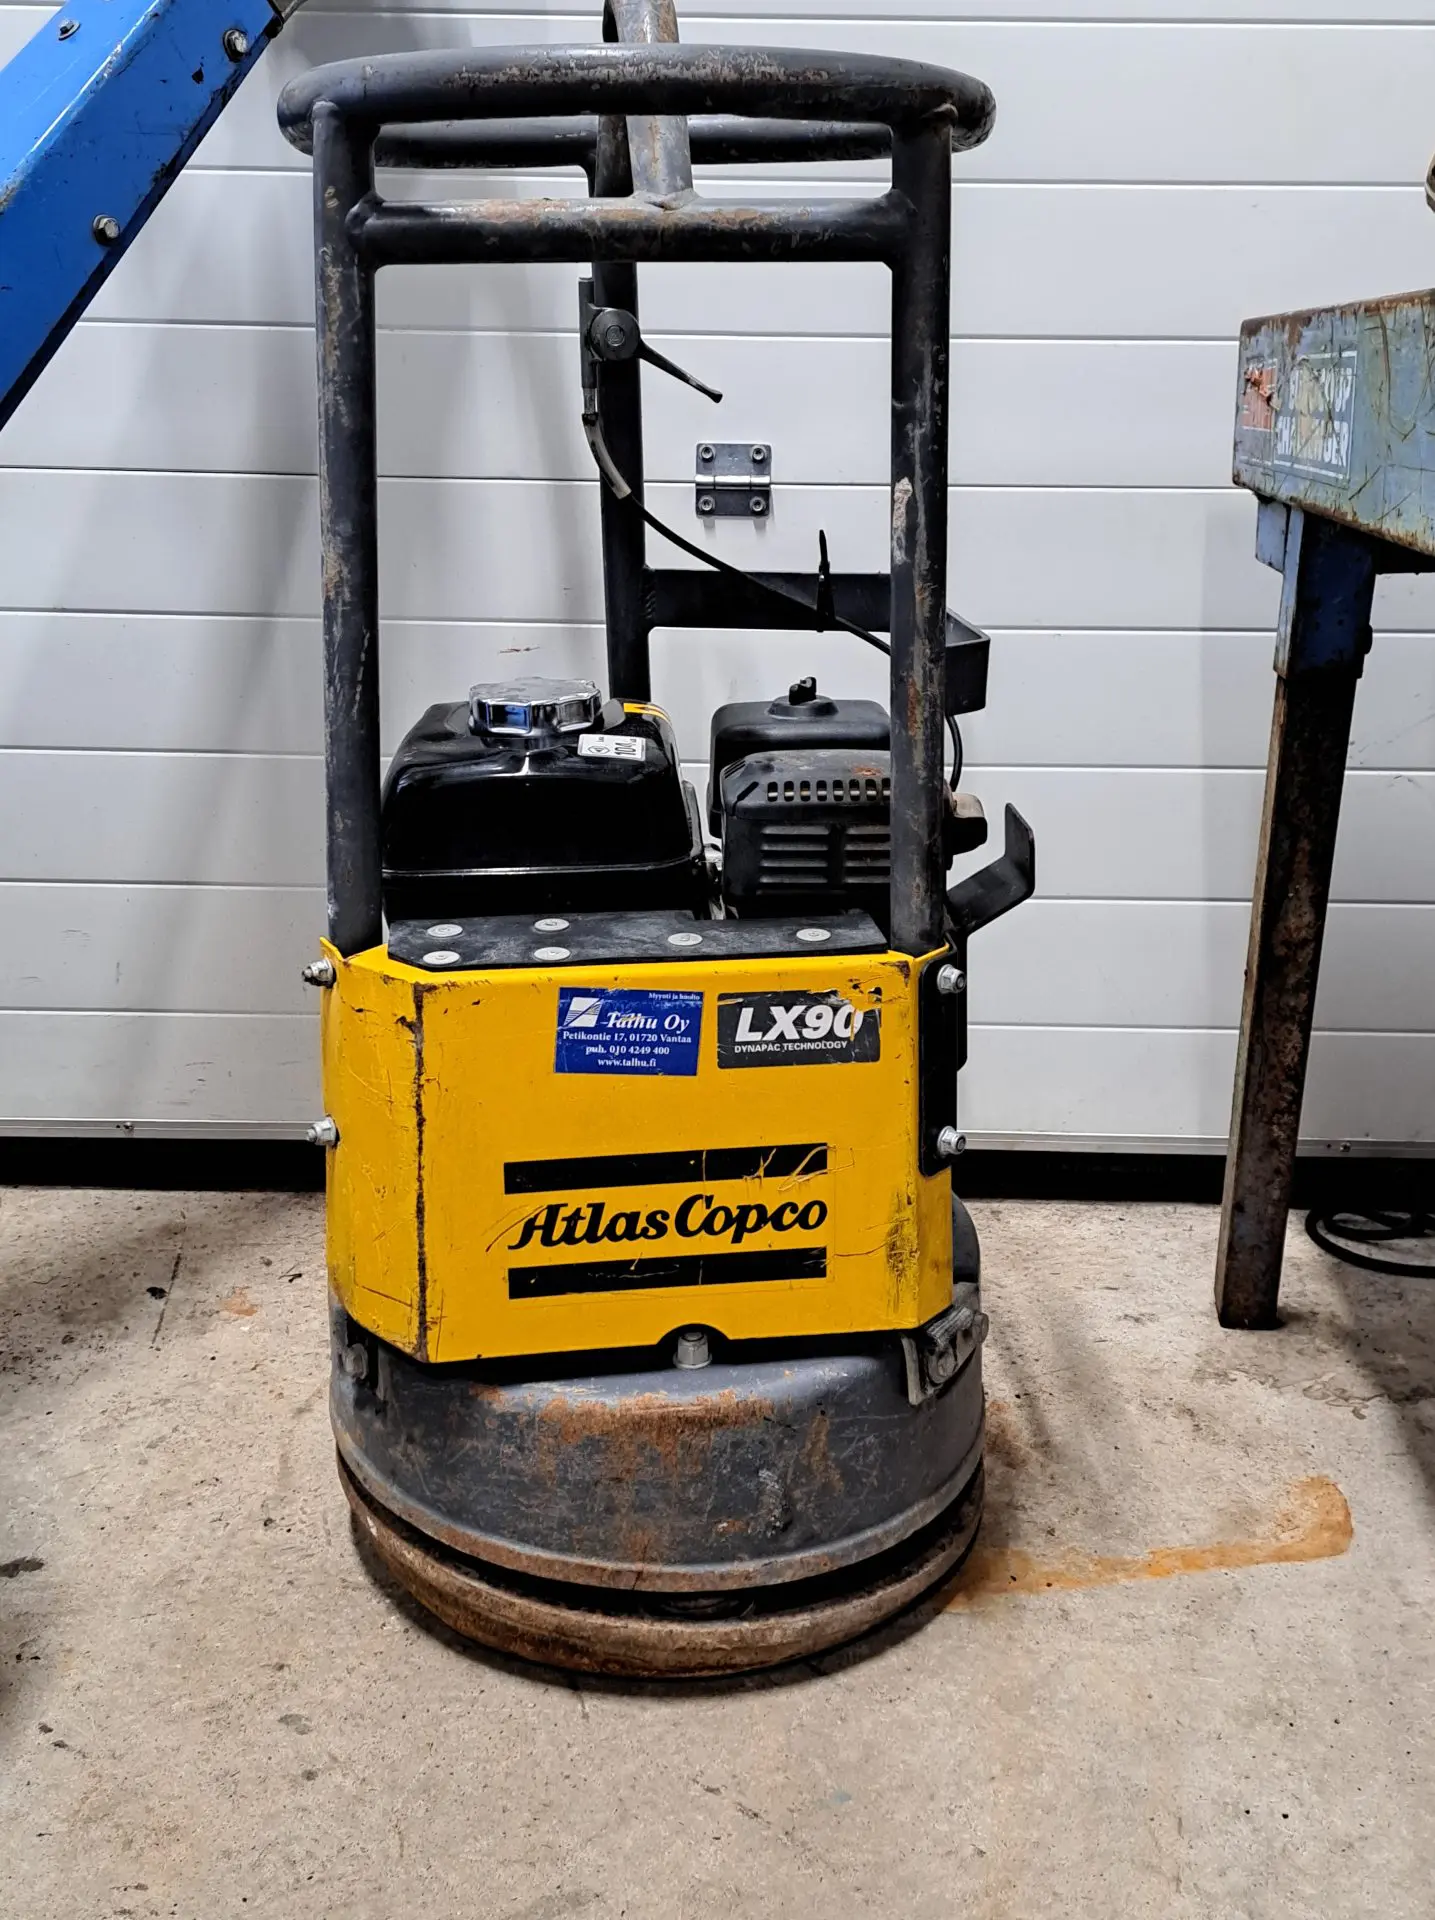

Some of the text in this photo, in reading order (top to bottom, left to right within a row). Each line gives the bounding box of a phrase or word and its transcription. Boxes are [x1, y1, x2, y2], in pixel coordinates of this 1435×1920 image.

[664, 1014, 690, 1034] Oy
[735, 1004, 864, 1042] LX90
[563, 1031, 692, 1043] Petikontie 17, 01720 Vantaa
[609, 1045, 626, 1055] 010
[628, 1046, 651, 1054] 4249
[652, 1046, 670, 1055] 400
[734, 1040, 848, 1054] DYNAPAC TECHNOLOGY
[598, 1058, 657, 1067] www.talhu.fi
[507, 1194, 828, 1250] Atlas Copco
